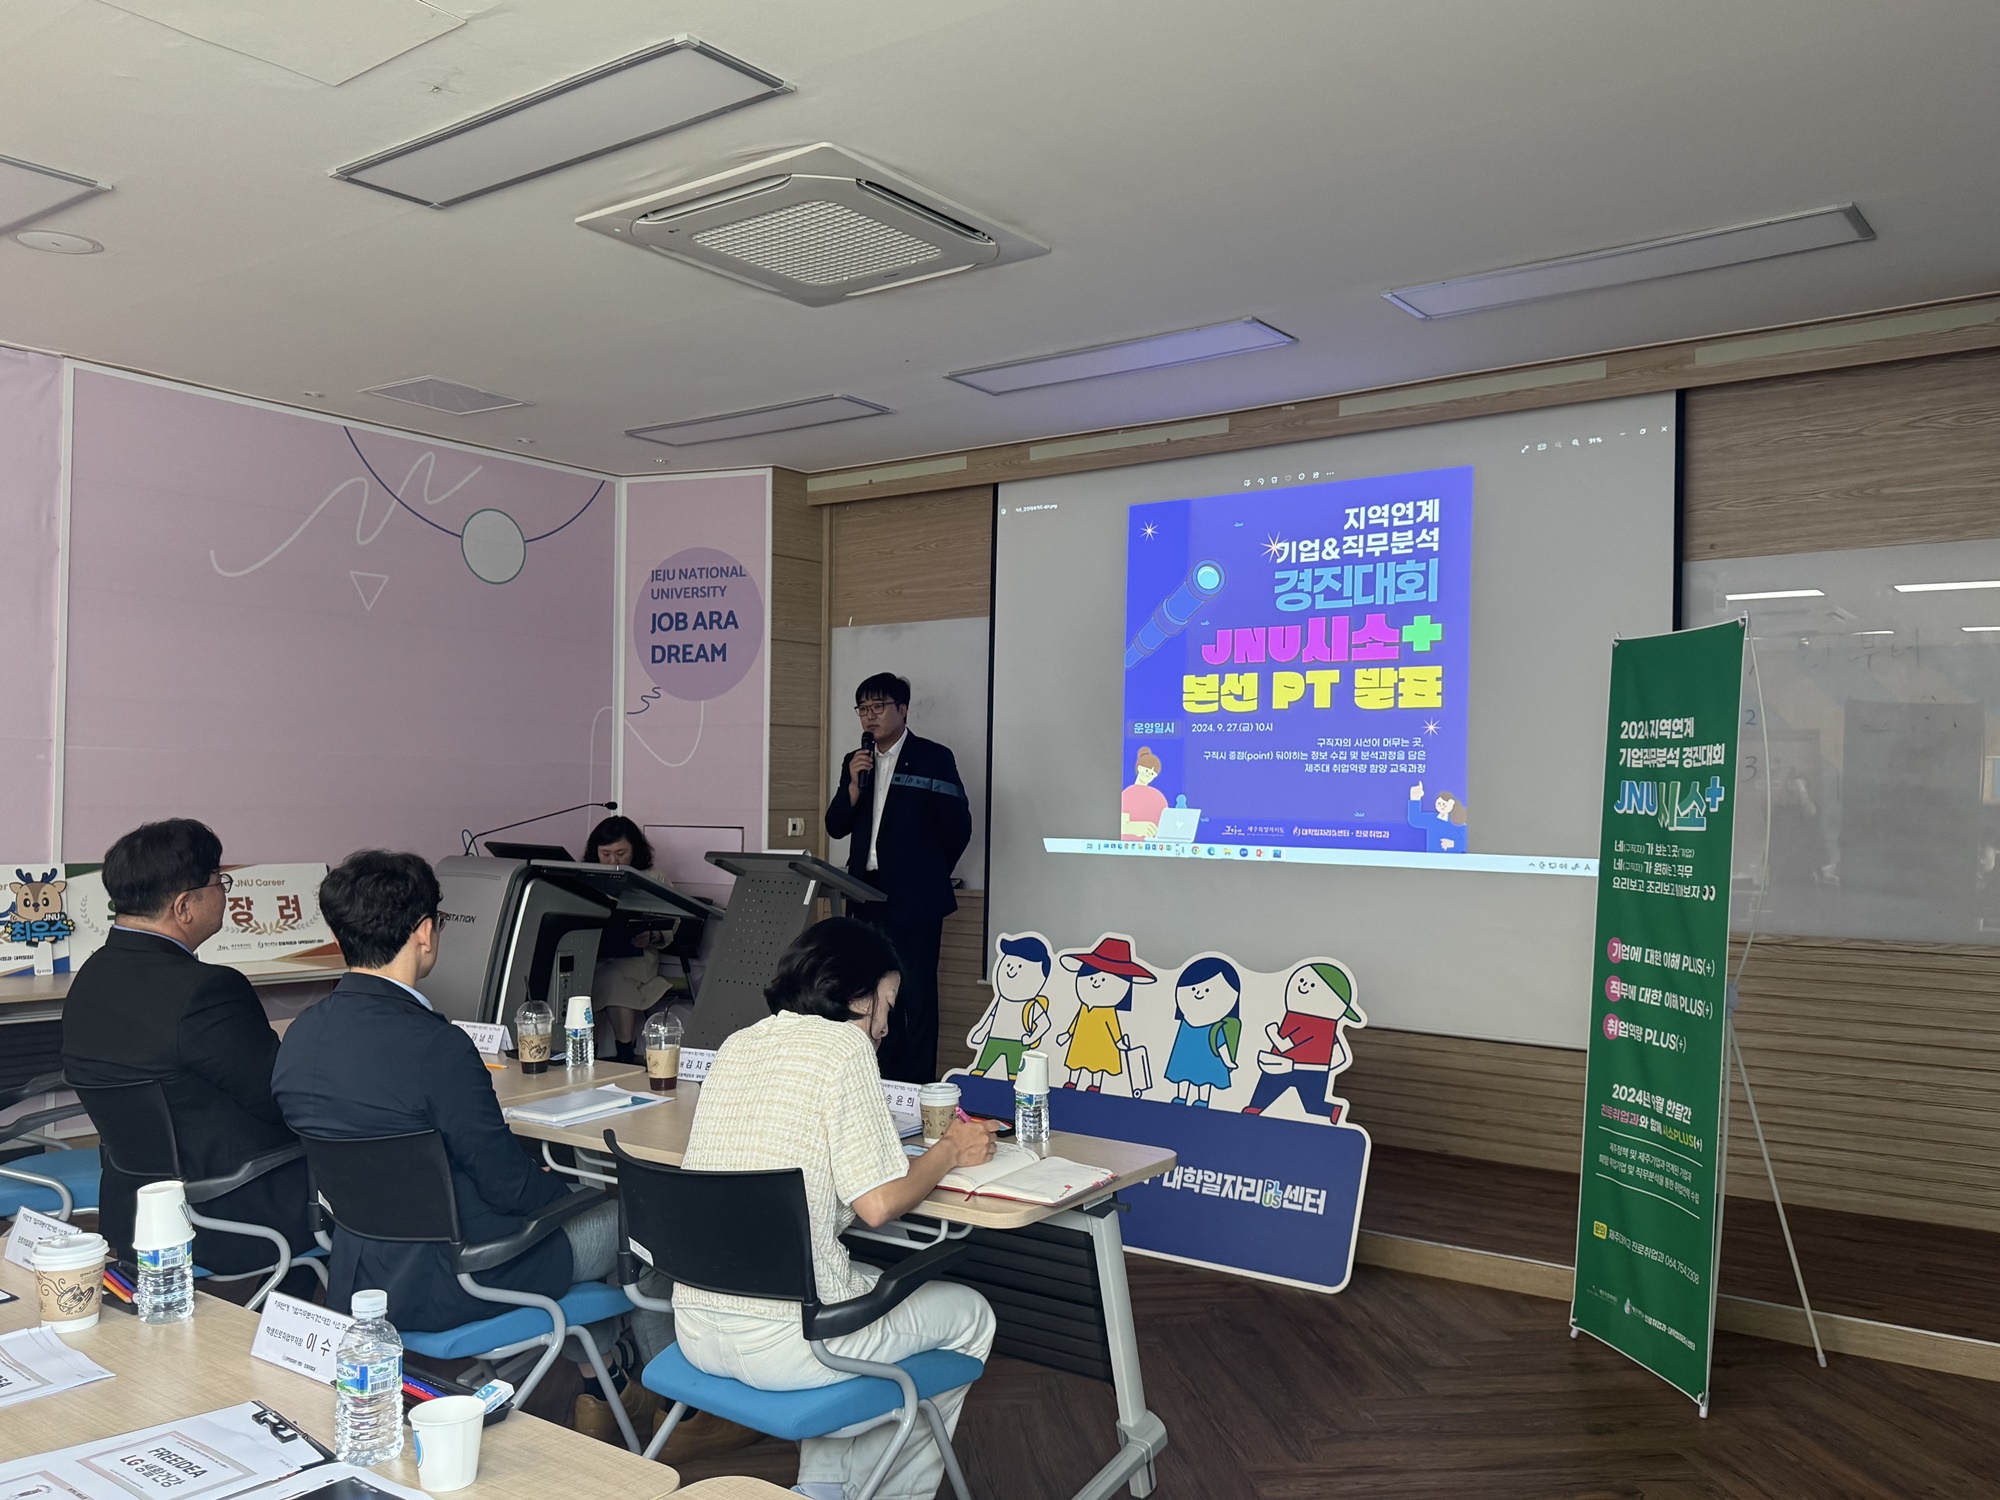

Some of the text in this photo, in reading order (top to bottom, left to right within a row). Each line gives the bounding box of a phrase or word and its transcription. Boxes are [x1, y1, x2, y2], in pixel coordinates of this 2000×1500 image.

[1344, 498, 1440, 530] 지역연계
[1276, 527, 1440, 564] 기업&직무분석
[651, 565, 747, 582] JEJU NATIONAL
[651, 585, 727, 600] UNIVERSITY
[1274, 558, 1439, 612] 경진대회
[650, 610, 739, 635] JOB ARA
[651, 642, 727, 664] DREAM
[1182, 665, 1443, 713] 본선 PT 발표
[1134, 722, 1175, 734] 운영일시
[1192, 723, 1215, 732] 2024.
[1255, 722, 1273, 732] 10시
[1745, 709, 1756, 725] 2
[1317, 738, 1350, 747] 구직자의
[1354, 738, 1380, 747] 시선이
[1383, 738, 1409, 747] 머무는
[1203, 751, 1226, 760] 구직시
[1311, 751, 1327, 760] 정보
[1330, 751, 1347, 760] 수집
[1350, 751, 1358, 760] 및
[1361, 751, 1405, 760] 분석과정을
[1408, 750, 1426, 760] 담은
[1682, 743, 1725, 768] 경진대회
[1305, 763, 1426, 773] 제주대 취업역량 함양 교육과정
[1742, 756, 1757, 783] 3
[234, 879, 285, 887] JNU Career
[1612, 876, 1644, 892] 요리보고
[43, 913, 60, 921] JNU
[11, 920, 71, 941] 최우수
[1612, 942, 1715, 977] 기업에 대한 이해 PLUS(+)
[1610, 980, 1637, 1001] 직무에
[1638, 987, 1662, 1006] 대한
[1607, 1018, 1686, 1054] 취업역량 PLUS(+)
[1665, 1099, 1692, 1125] 한달간
[1630, 1149, 1637, 1161] 및
[1632, 1241, 1664, 1263] 진로취업과
[120, 1454, 146, 1467] LG
[134, 1463, 187, 1488] 생활건강
[148, 1447, 208, 1479] FREEIDEA
